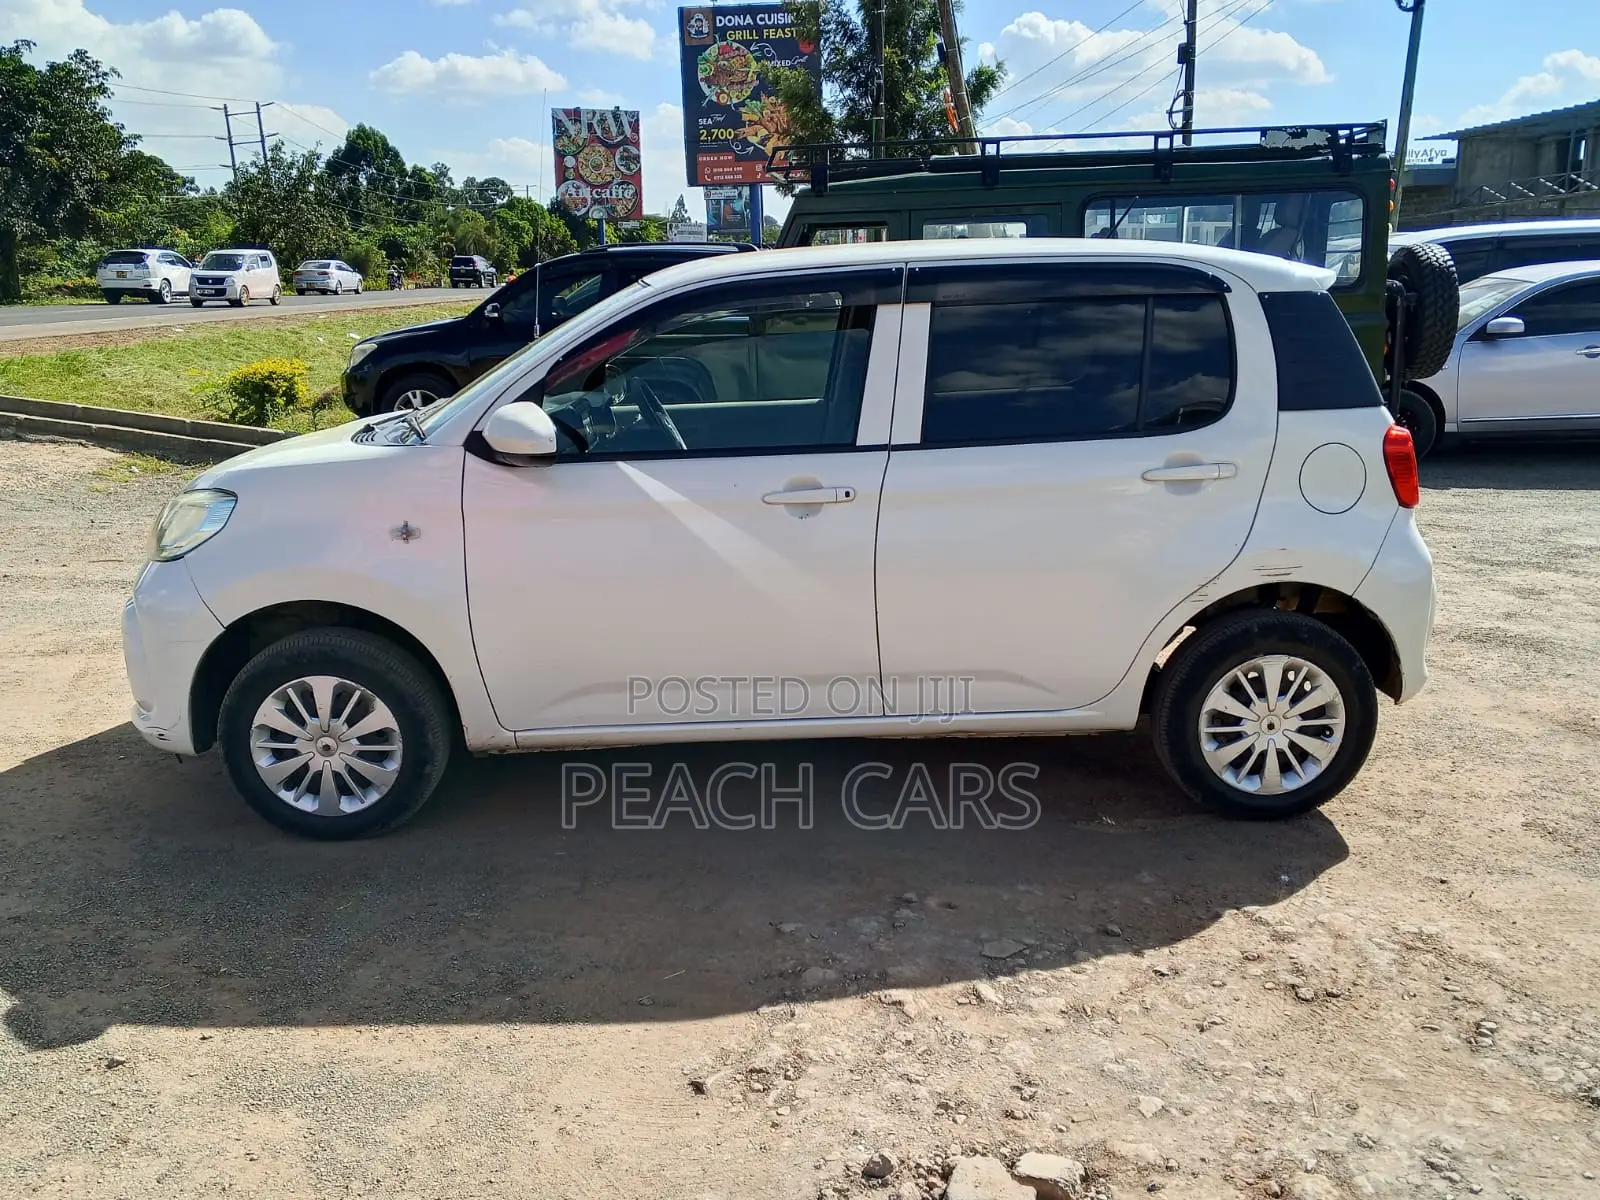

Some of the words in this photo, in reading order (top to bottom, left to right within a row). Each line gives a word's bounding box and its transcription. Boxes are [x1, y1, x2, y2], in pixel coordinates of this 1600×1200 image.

[716, 14, 753, 27] DONA
[726, 30, 759, 41] GRILL
[763, 27, 797, 39] FEAST
[698, 118, 713, 126] SEA
[699, 128, 735, 141] 2,700
